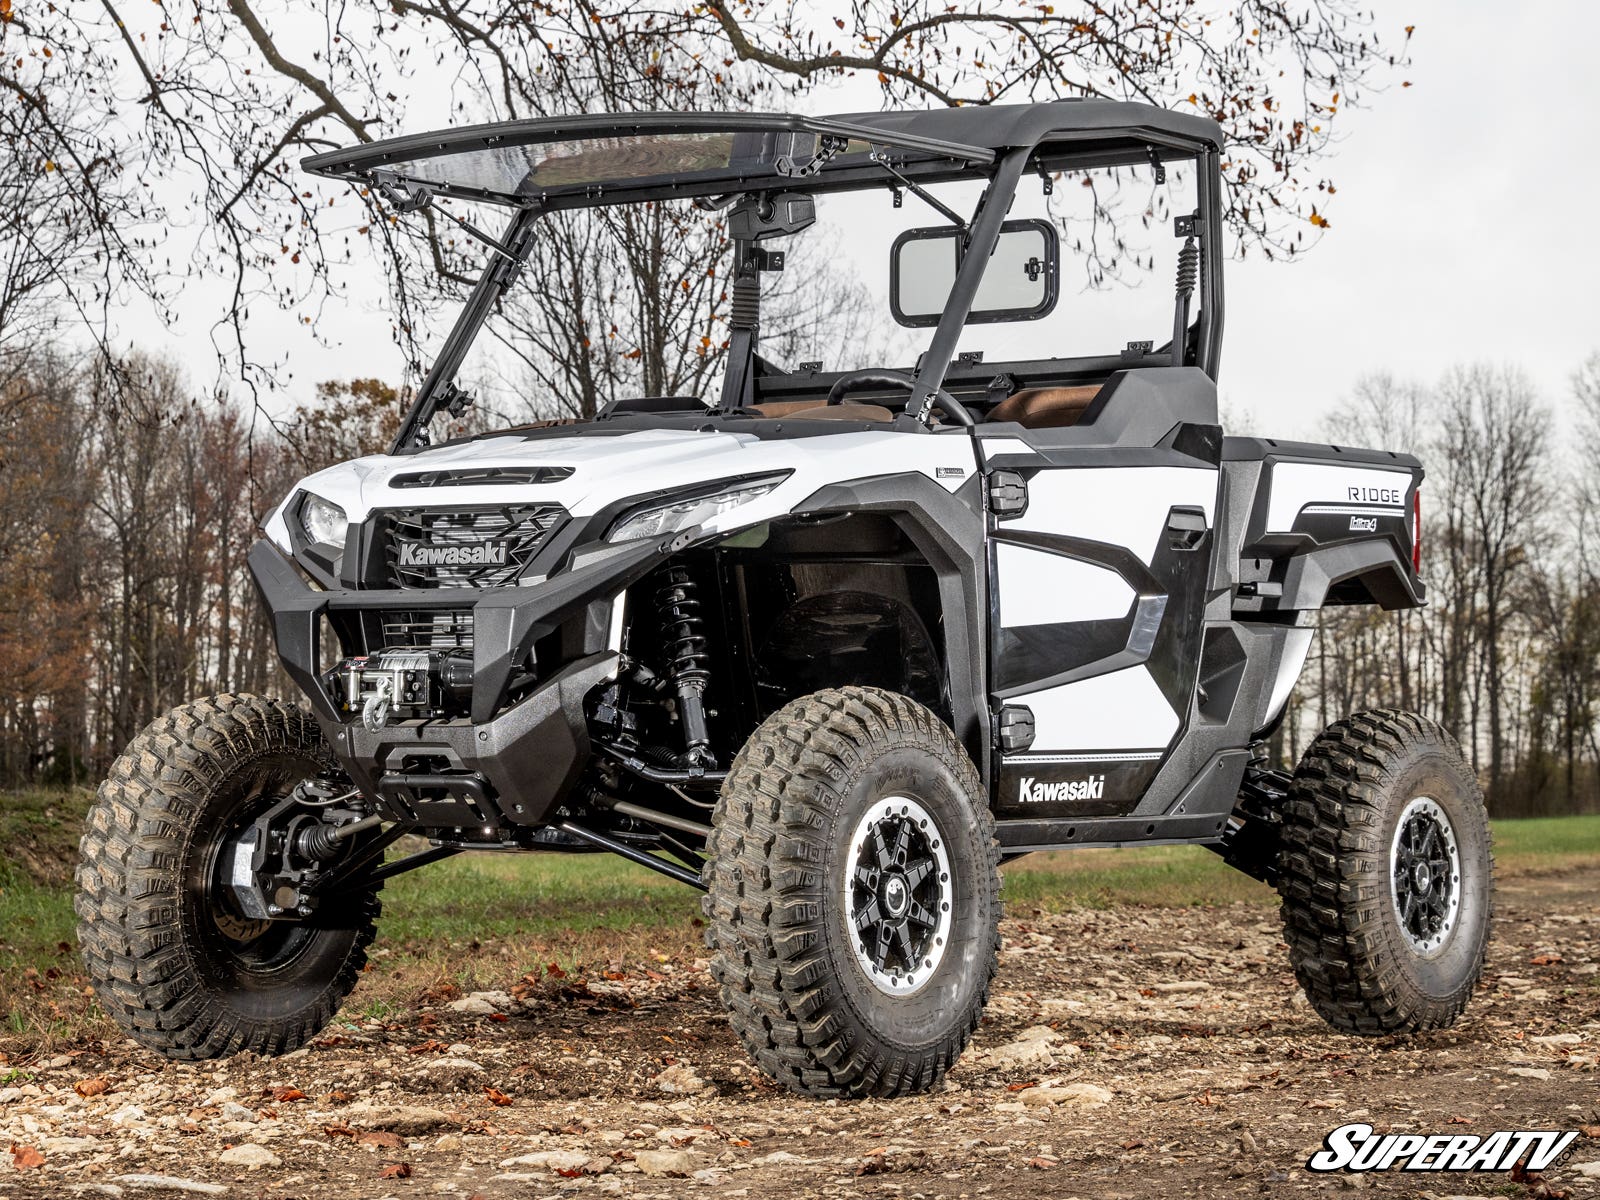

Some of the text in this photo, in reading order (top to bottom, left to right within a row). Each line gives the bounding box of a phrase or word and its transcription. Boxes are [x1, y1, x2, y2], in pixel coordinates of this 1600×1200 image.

[1348, 487, 1400, 503] RIDGE
[400, 541, 507, 566] Kawasaki
[1019, 775, 1105, 803] Kawasaki
